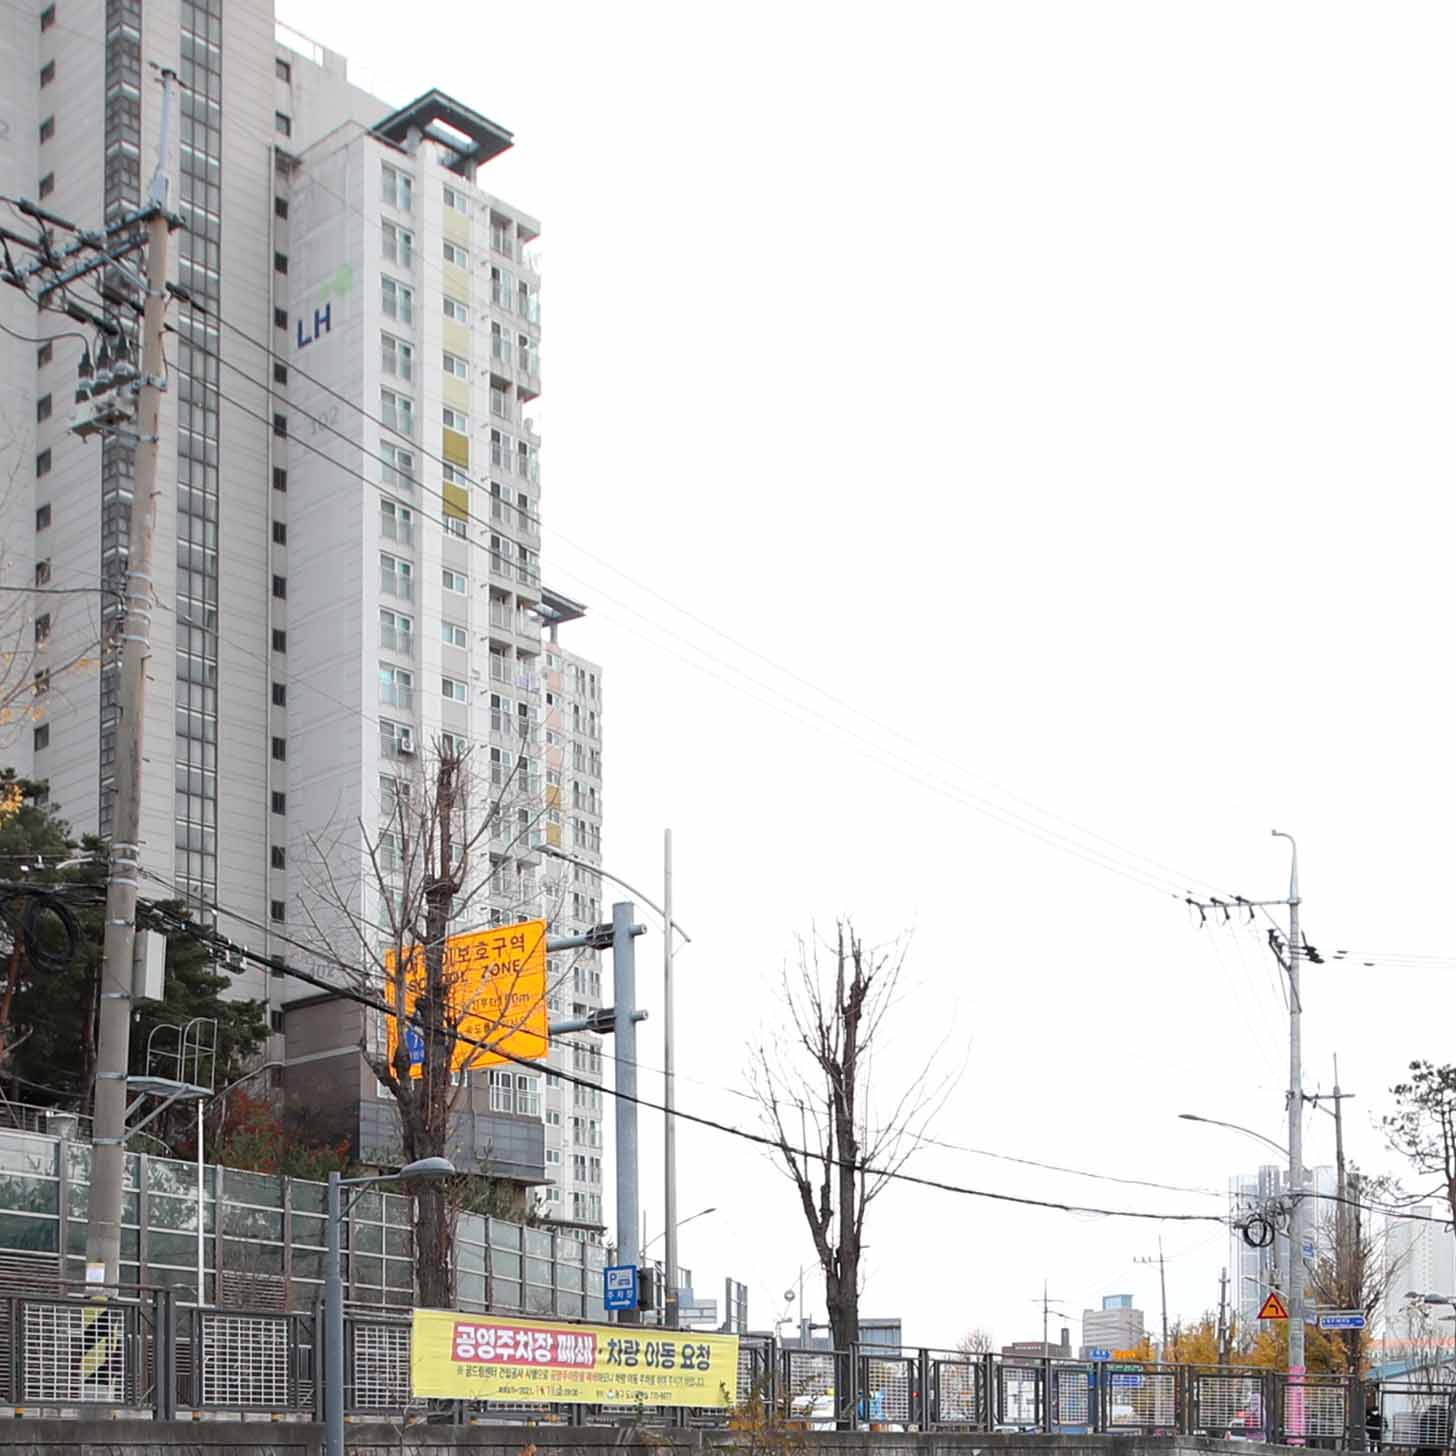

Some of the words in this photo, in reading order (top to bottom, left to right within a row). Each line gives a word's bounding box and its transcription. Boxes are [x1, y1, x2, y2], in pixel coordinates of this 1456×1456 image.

[298, 301, 331, 349] LH
[456, 1326, 553, 1363] 공영주차장
[557, 1335, 593, 1365] 폐쇄
[607, 1338, 641, 1367] 차량
[645, 1341, 676, 1369] 이동
[681, 1344, 711, 1371] 요청
